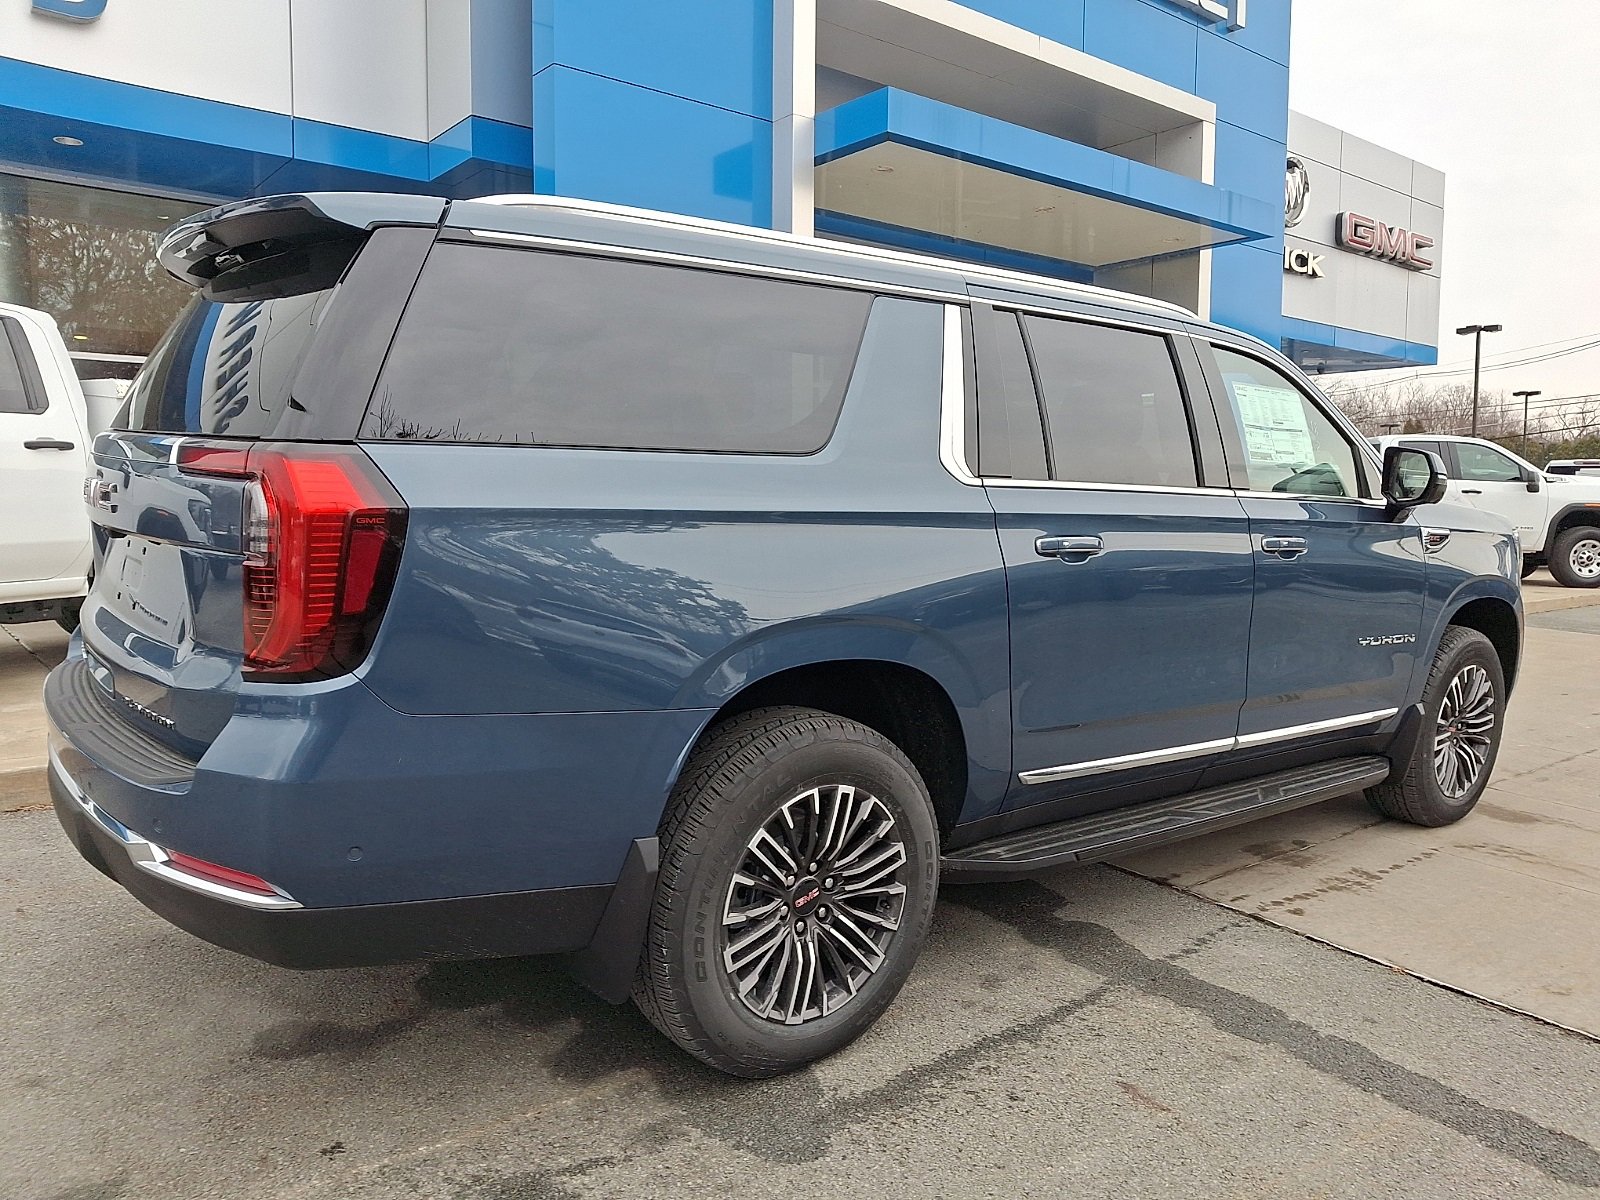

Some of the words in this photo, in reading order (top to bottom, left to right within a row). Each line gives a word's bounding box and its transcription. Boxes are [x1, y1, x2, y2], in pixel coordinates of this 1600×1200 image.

[1339, 211, 1434, 271] GMC
[1284, 246, 1326, 278] ICK
[1359, 633, 1416, 646] YUKON
[795, 887, 820, 908] GMC
